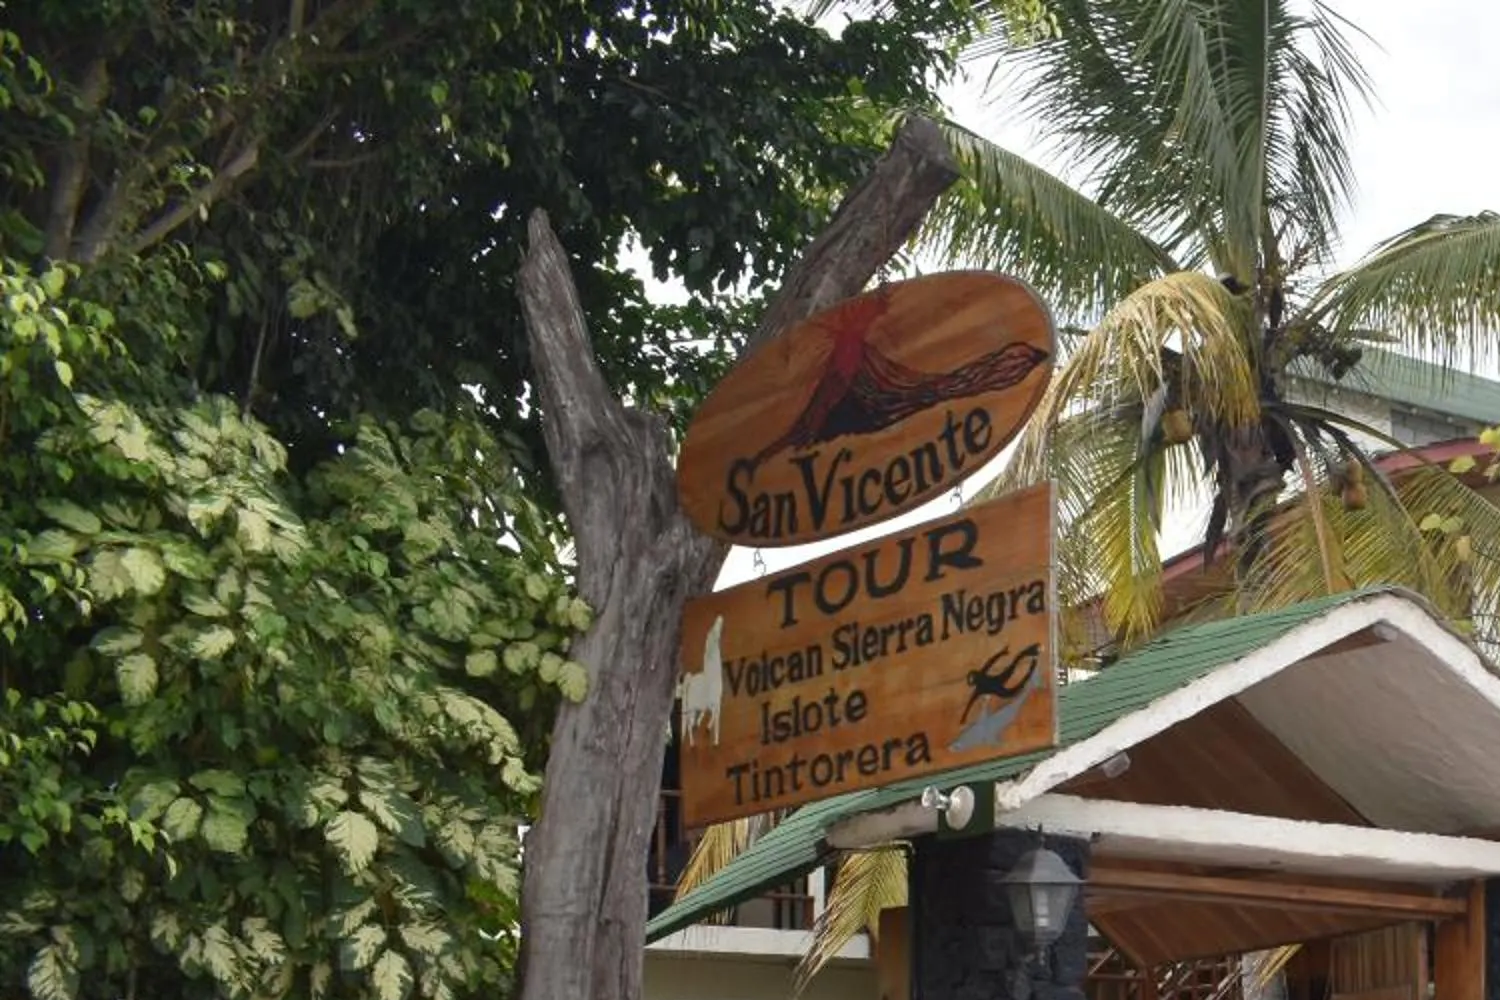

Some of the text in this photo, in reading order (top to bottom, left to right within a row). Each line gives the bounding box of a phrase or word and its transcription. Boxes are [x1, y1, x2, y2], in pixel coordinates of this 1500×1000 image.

[718, 406, 992, 539] San Vicente
[768, 518, 984, 629] TOUR
[722, 579, 1046, 698] Volcan Sierra Negra
[726, 731, 931, 806] Tintorera
[760, 690, 868, 745] Islote
